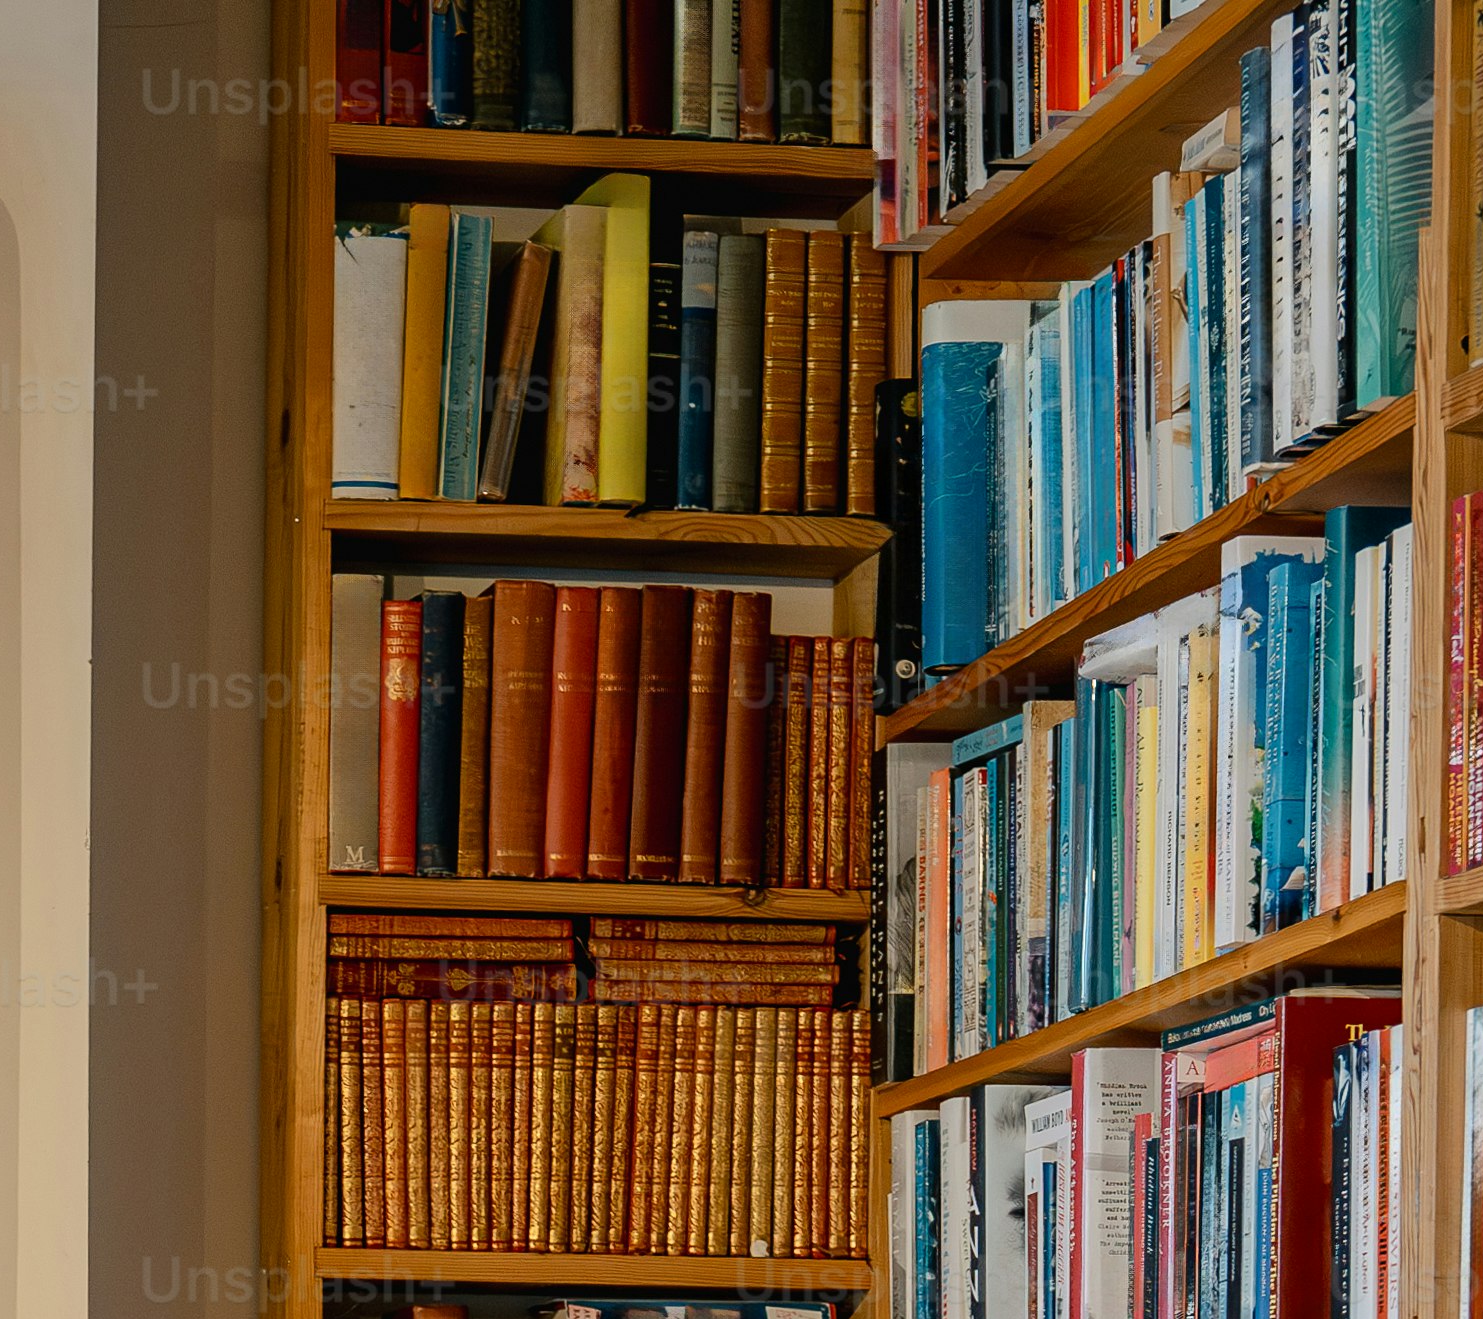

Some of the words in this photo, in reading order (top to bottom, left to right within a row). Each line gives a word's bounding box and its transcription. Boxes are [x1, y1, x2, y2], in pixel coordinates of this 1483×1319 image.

[1153, 246, 1163, 284] The
[1152, 289, 1163, 354] Hiding
[345, 845, 365, 862] M
[1162, 1061, 1173, 1117] ANITA
[1162, 1127, 1173, 1229] BROOKNER
